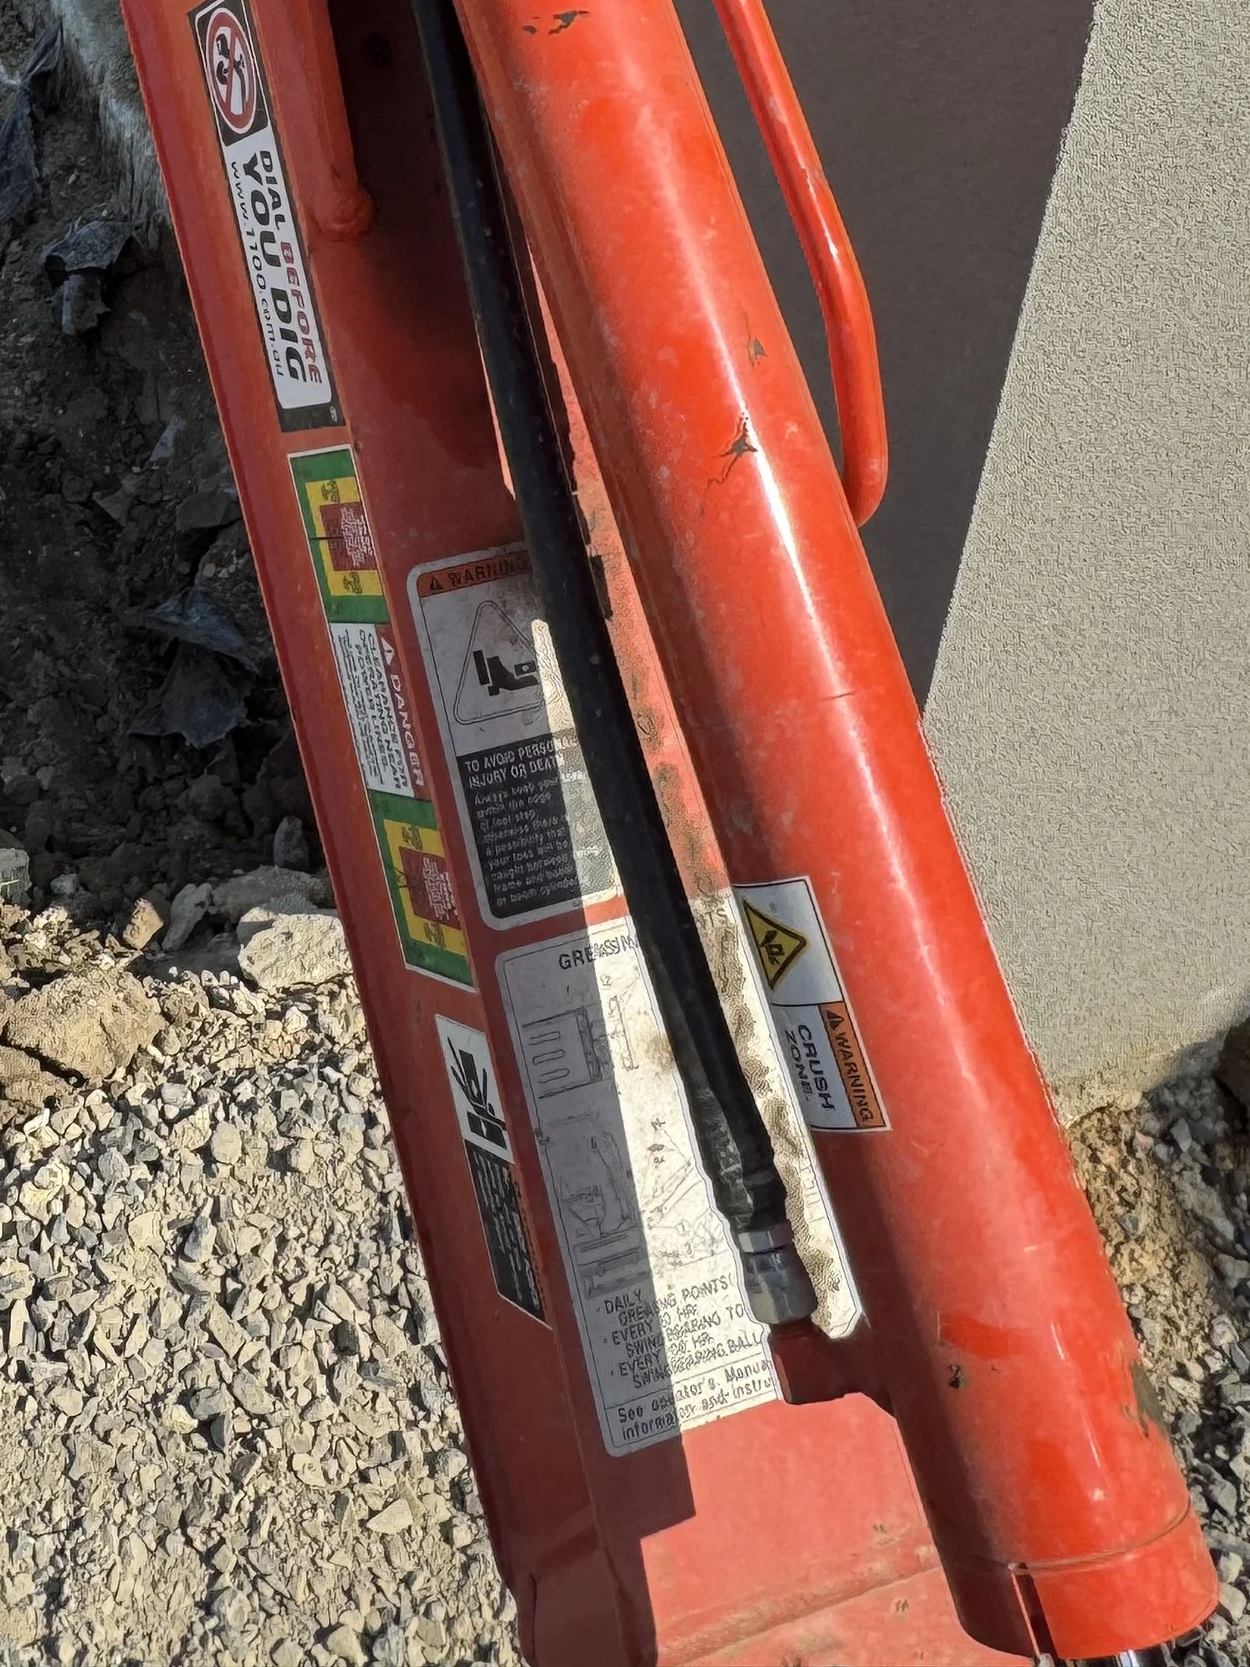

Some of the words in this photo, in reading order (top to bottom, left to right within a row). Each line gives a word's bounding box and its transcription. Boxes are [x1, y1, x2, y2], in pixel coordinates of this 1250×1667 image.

[231, 161, 284, 376] www.1100.com.au
[243, 153, 281, 268] YOU
[270, 287, 307, 383] DIG
[260, 150, 285, 230] DIAL
[280, 241, 322, 384] BEFORE
[391, 675, 424, 786] DANGER
[465, 759, 480, 773] TO
[484, 749, 515, 768] AVOID
[469, 770, 506, 788] INJURY
[511, 765, 526, 778] OR
[799, 1024, 835, 1110] CRUSH
[835, 1032, 873, 1122] WARNING
[605, 1289, 643, 1314] DAILY
[612, 1320, 653, 1346] EVERY
[619, 1352, 661, 1376] EVERY
[618, 1405, 643, 1423] See
